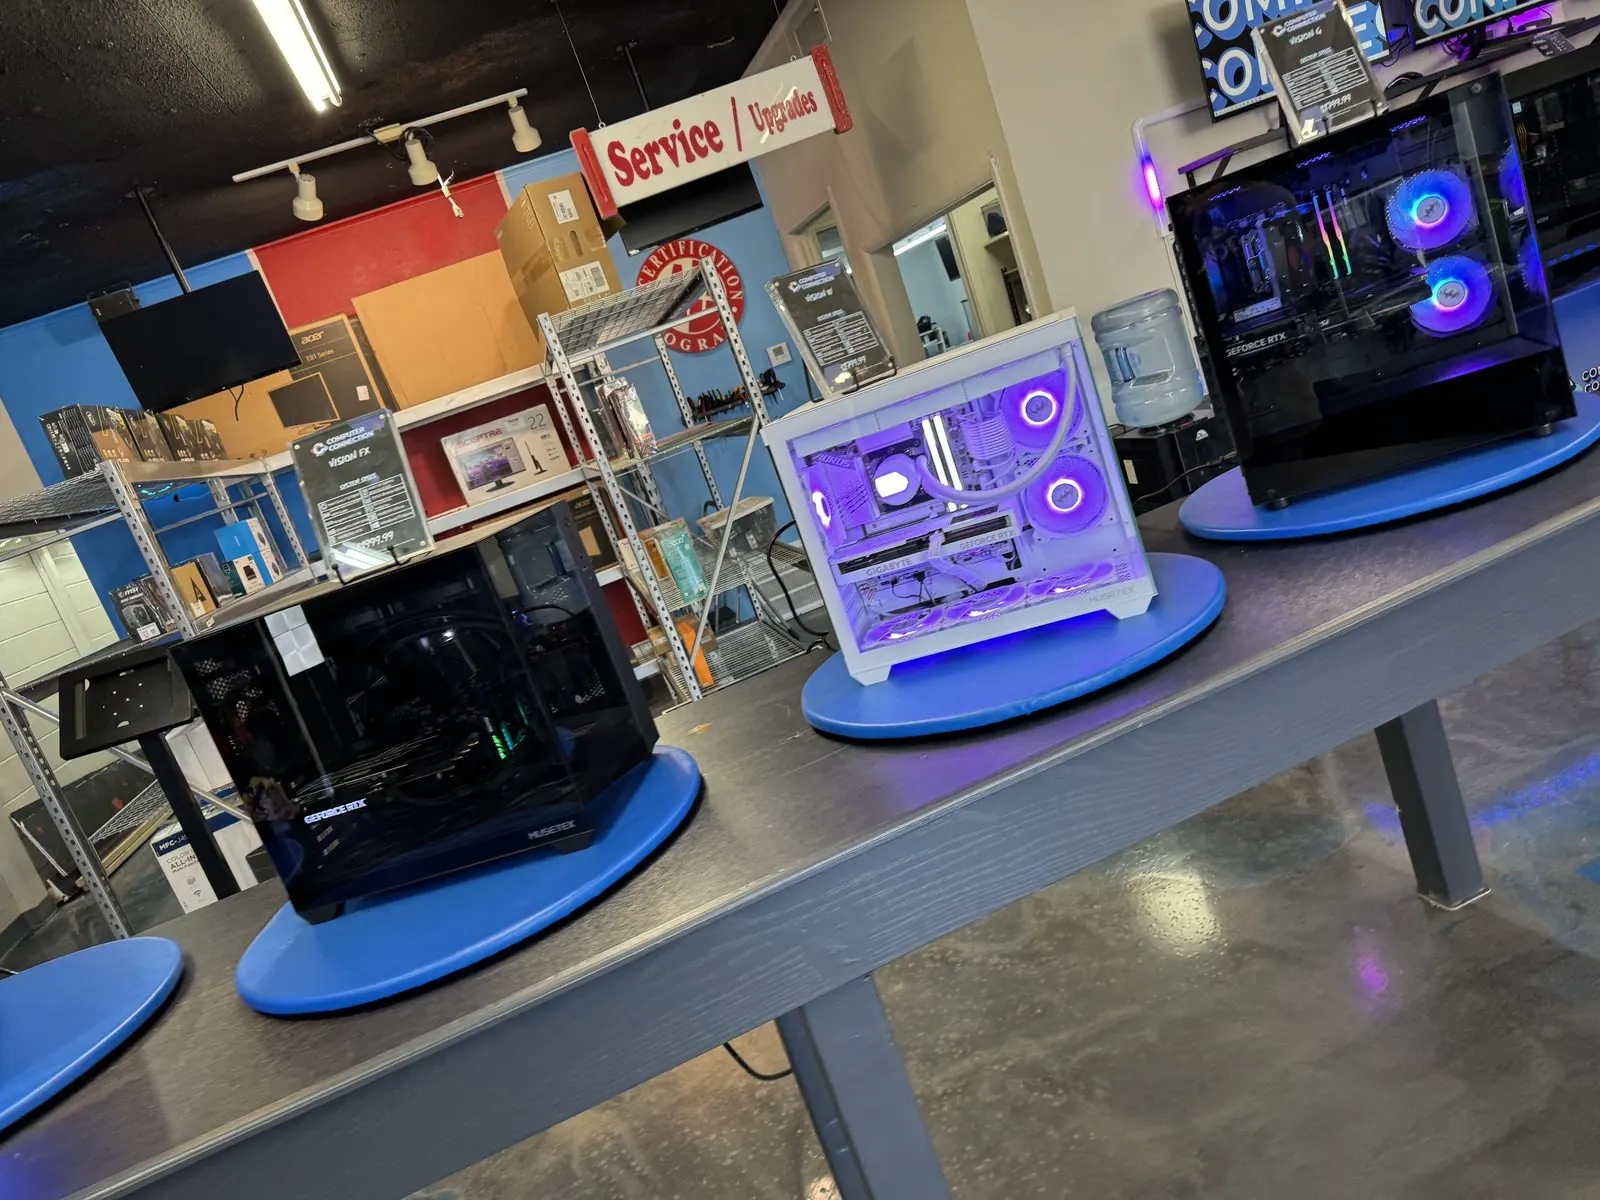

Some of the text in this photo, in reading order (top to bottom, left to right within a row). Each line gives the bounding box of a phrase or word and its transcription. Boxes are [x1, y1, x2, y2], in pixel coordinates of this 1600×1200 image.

[607, 118, 724, 187] Service
[747, 90, 818, 136] Upgrades
[301, 330, 325, 345] acer
[663, 327, 726, 352] OGRA
[1225, 332, 1287, 357] GEFORCE RTX
[317, 348, 335, 359] Series
[527, 412, 547, 430] 22
[326, 426, 365, 445] COMPUTER
[328, 430, 375, 451] CONNECTION
[456, 427, 504, 449] SCEPTRE
[328, 446, 371, 468] VISION FX
[959, 528, 1015, 551] GEFORCE RTX
[866, 557, 913, 577] GIGABYTE
[304, 804, 348, 824] GEFORCE
[166, 850, 190, 864] COLOR
